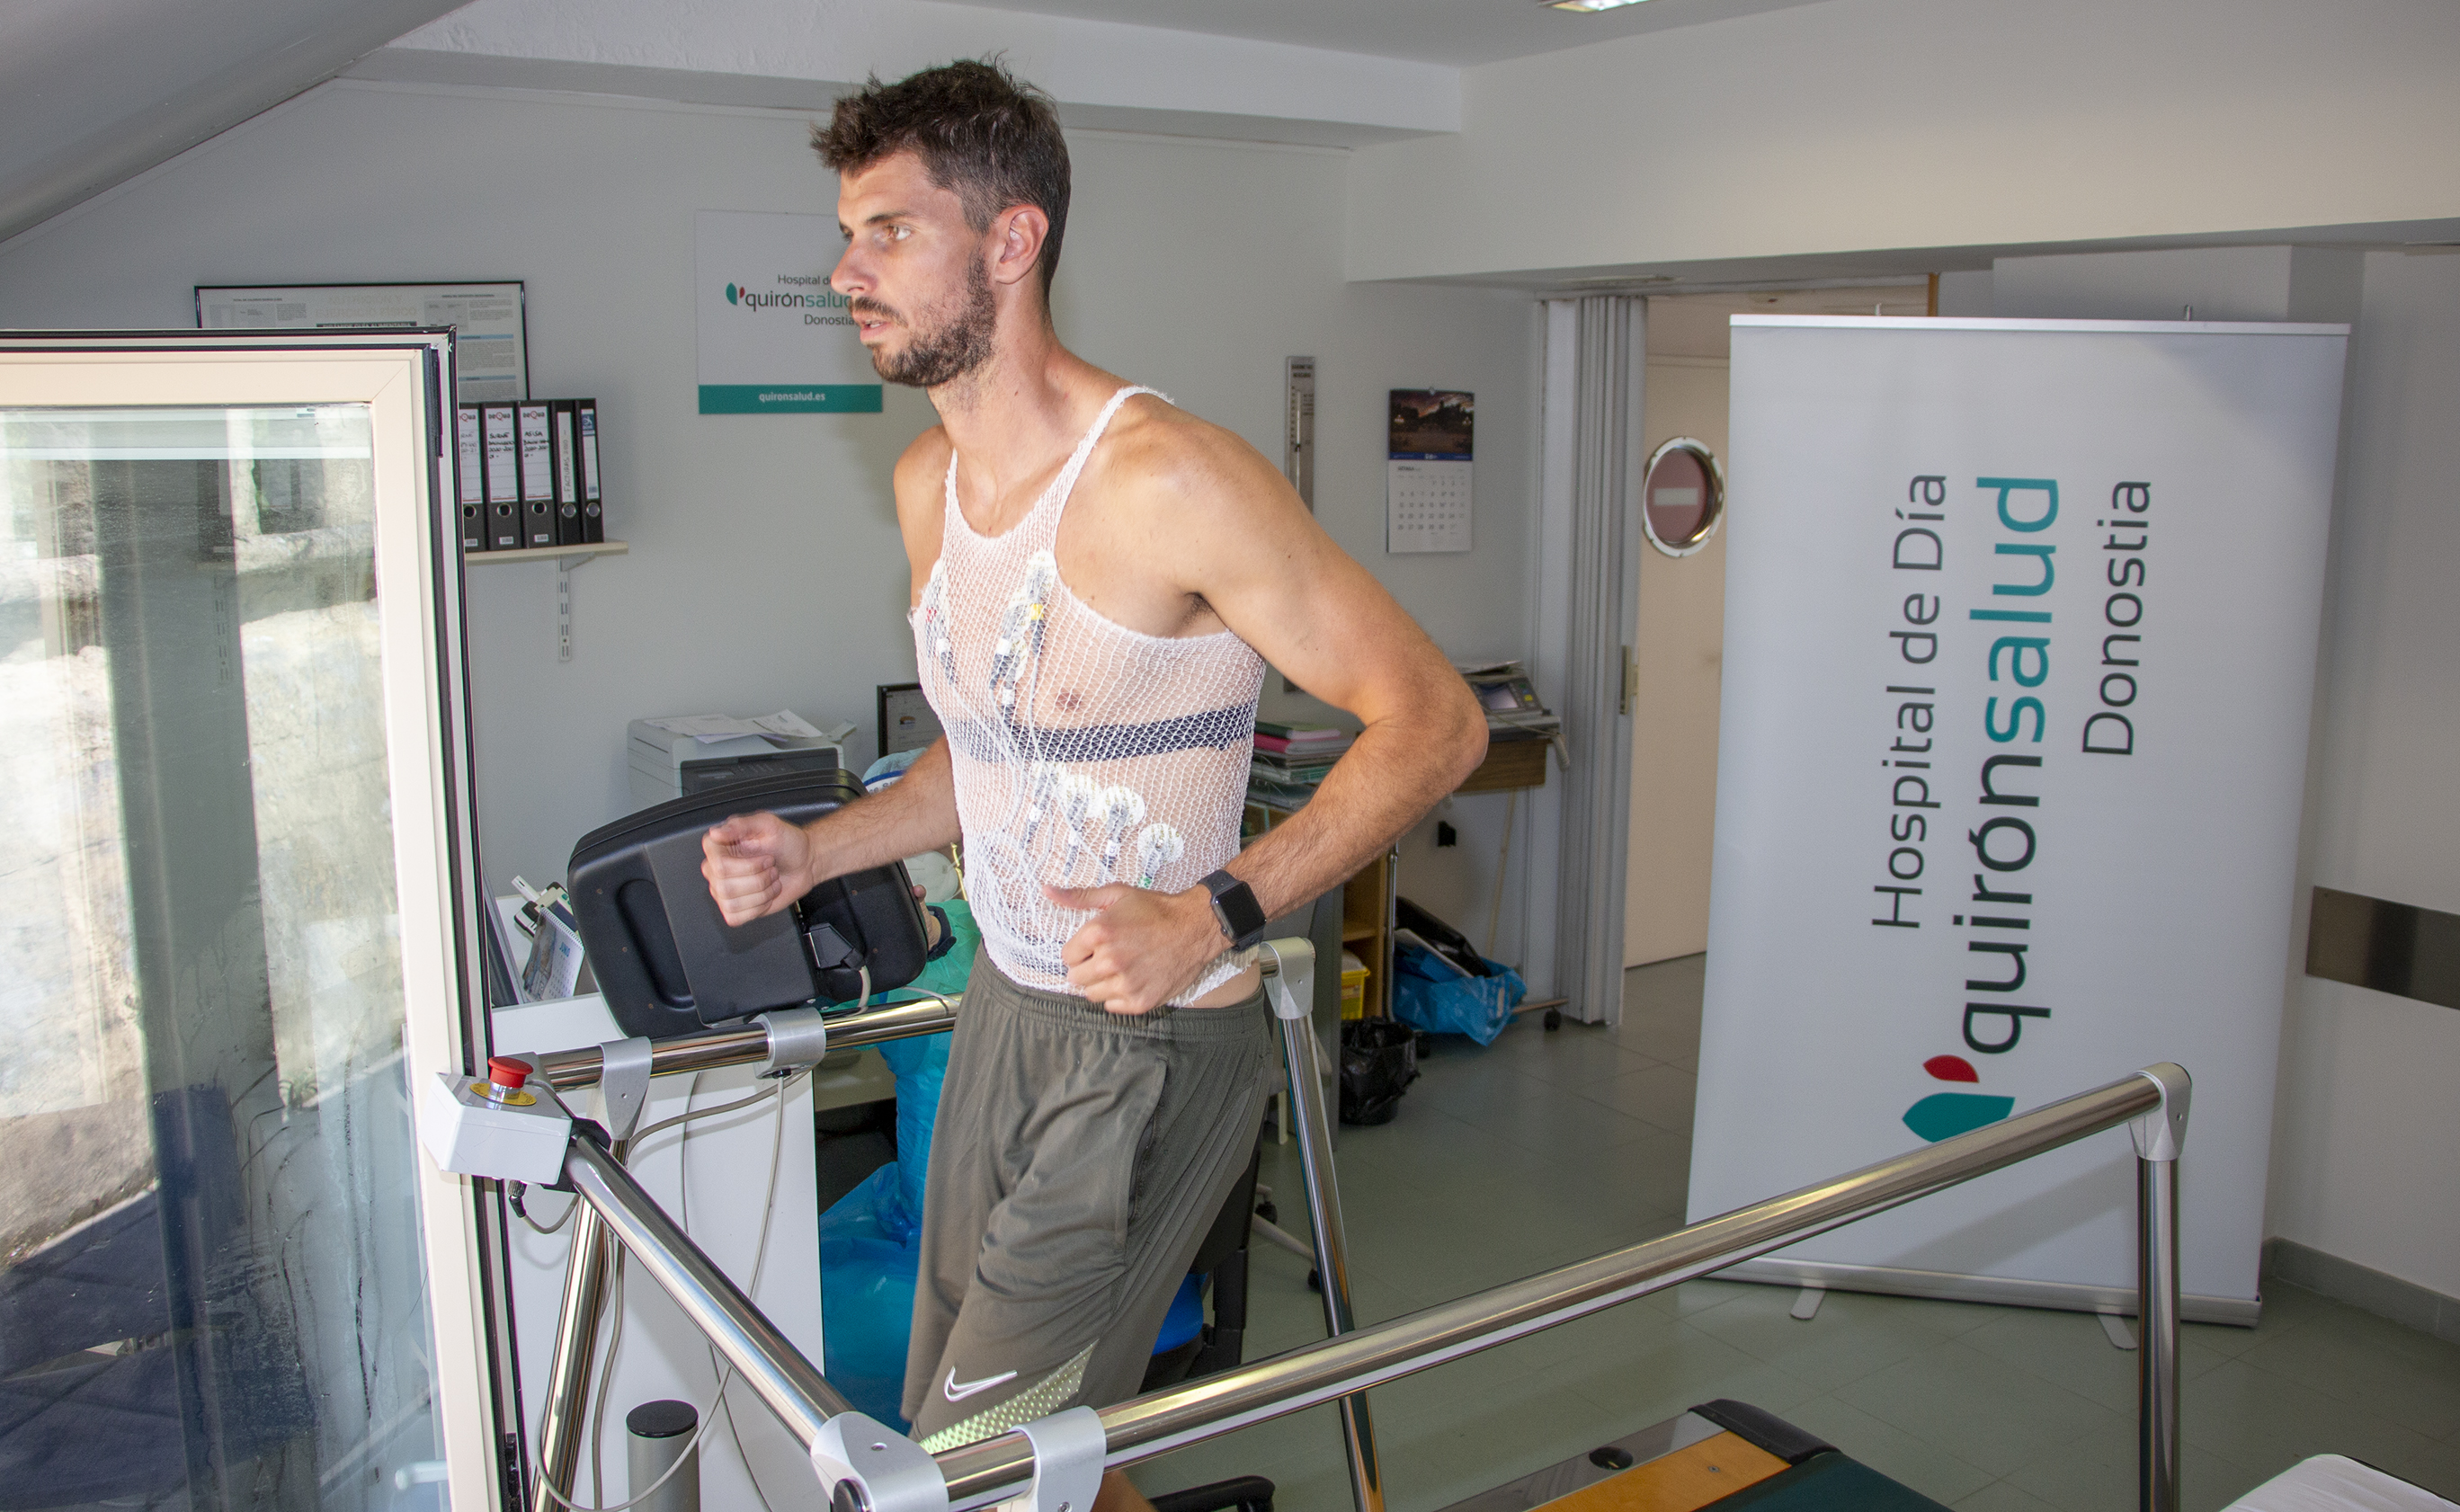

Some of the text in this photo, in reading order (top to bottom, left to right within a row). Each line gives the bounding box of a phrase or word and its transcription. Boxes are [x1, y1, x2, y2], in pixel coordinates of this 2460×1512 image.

[777, 274, 821, 287] Hospital
[804, 314, 856, 325] Donostia
[759, 392, 825, 403] quironsalud.es
[2081, 480, 2152, 756] Donostia
[1871, 474, 1947, 929] Hospital de Día
[1952, 476, 2059, 1054] quirónsalud
